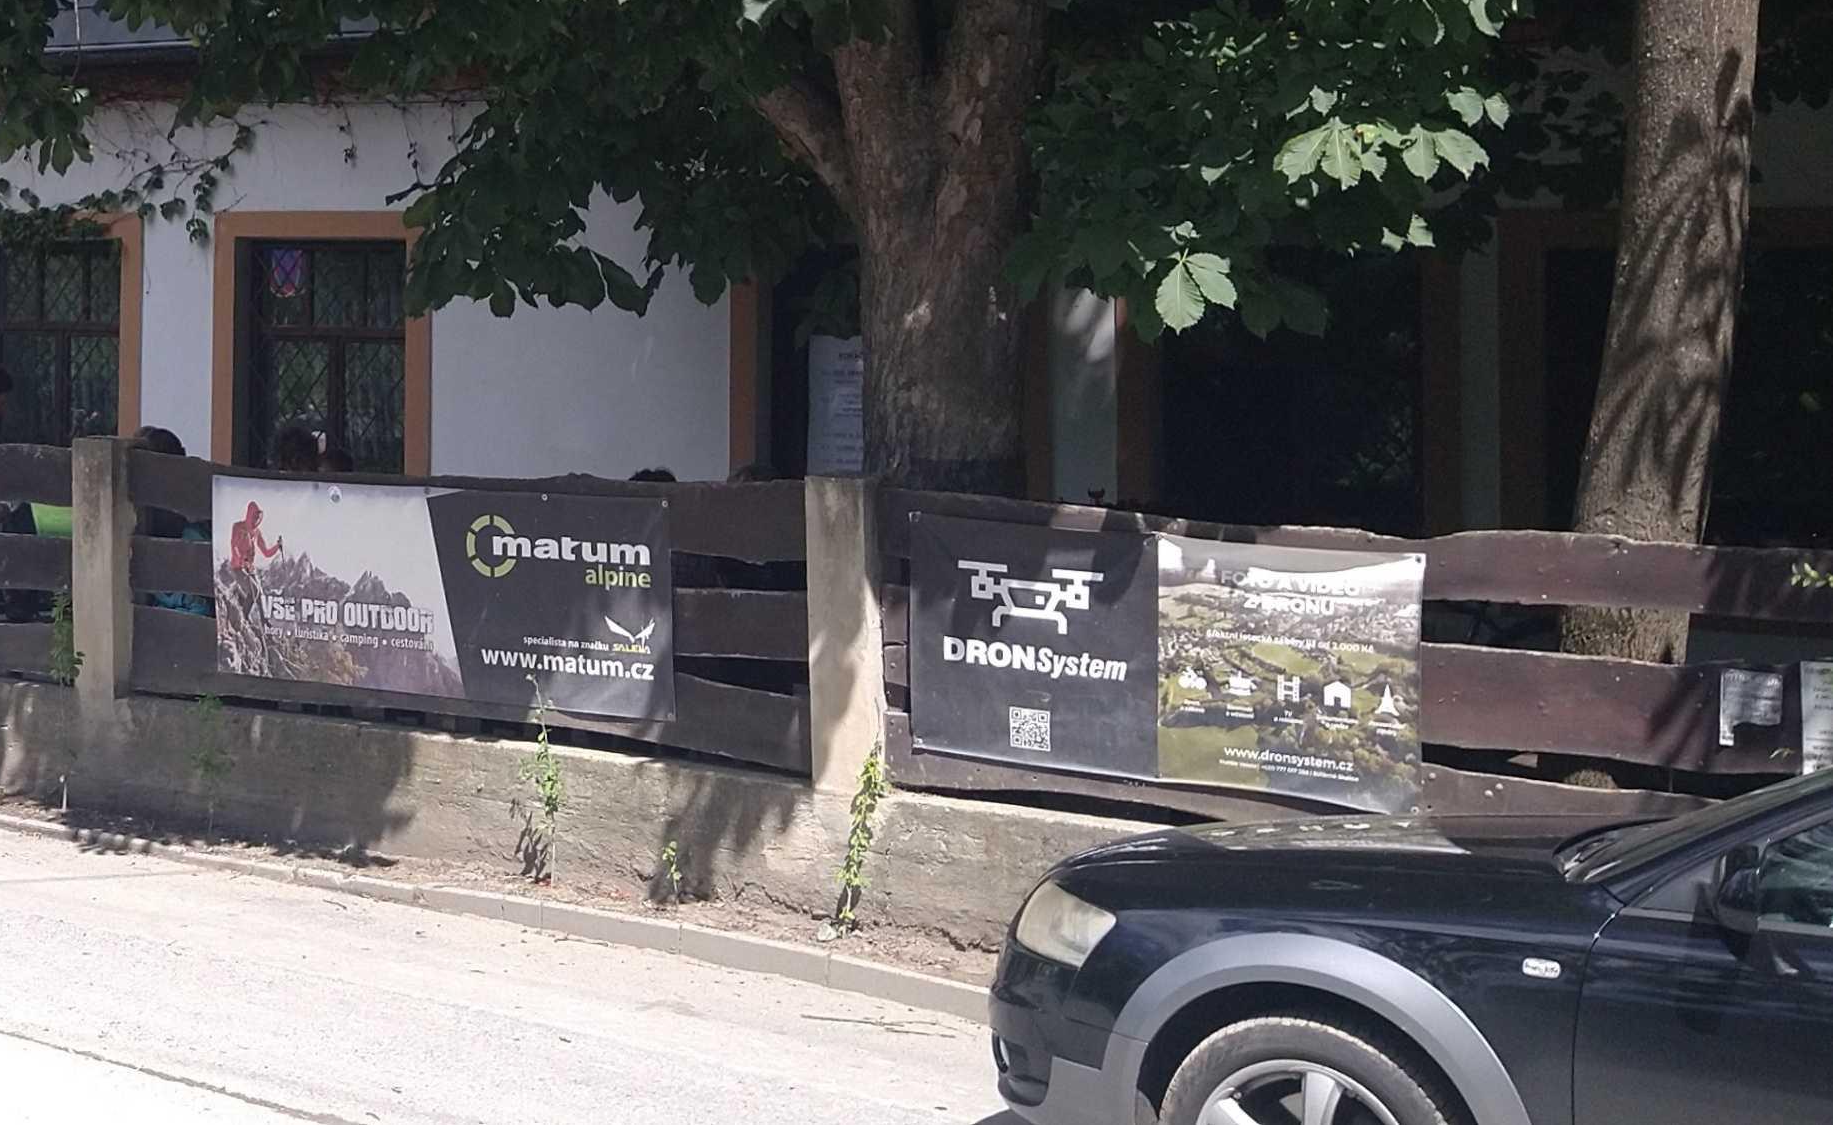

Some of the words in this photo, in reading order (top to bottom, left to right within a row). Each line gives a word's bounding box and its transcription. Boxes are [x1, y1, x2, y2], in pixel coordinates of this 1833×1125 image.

[492, 535, 651, 566] matum
[585, 565, 652, 591] alpine
[261, 589, 296, 622] VŠE
[301, 598, 338, 625] PRO
[344, 602, 434, 634] OUTDOOR
[294, 629, 329, 642] turistika
[340, 633, 378, 648] camping
[523, 635, 567, 647] specialista
[481, 648, 654, 681] www.matum.cz
[943, 635, 1127, 681] DRONSystem
[1224, 746, 1354, 773] www.dronsystem.cz
